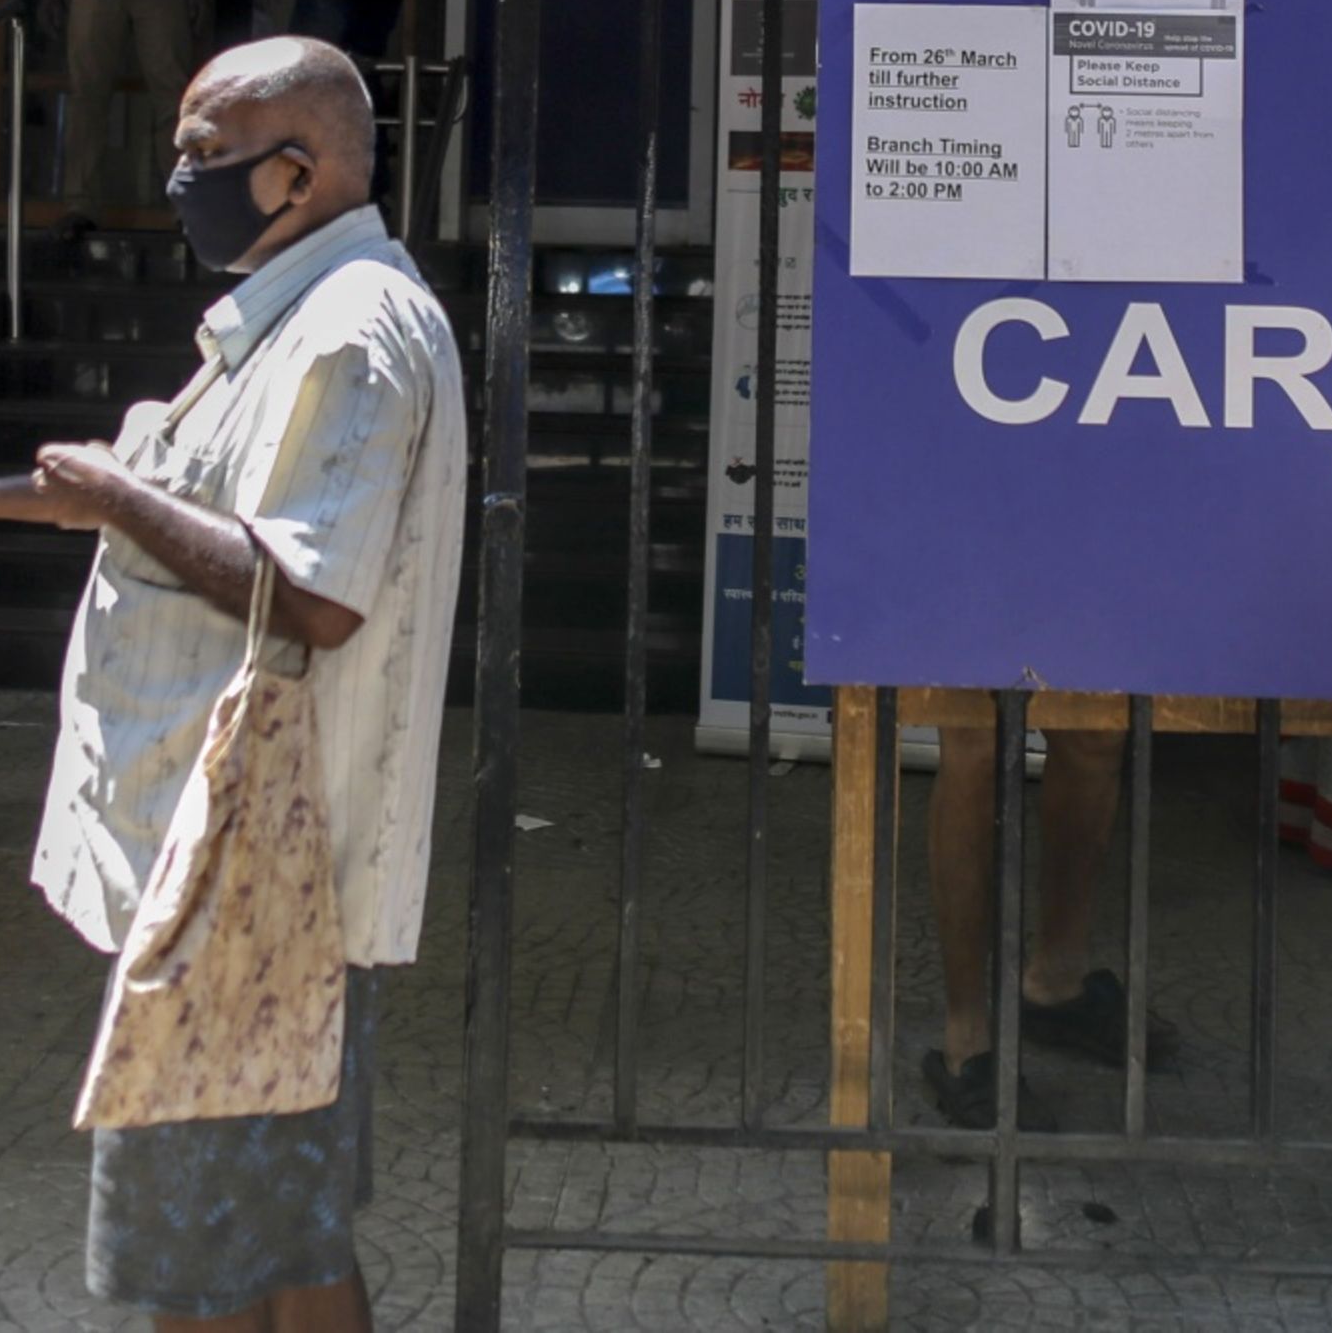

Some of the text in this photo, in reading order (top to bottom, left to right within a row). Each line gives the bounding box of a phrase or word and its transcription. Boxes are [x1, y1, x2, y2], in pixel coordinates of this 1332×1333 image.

[1069, 20, 1155, 38] COVID-19
[1069, 40, 1095, 49] Novel
[869, 47, 917, 64] From
[961, 50, 1017, 67] March
[1077, 59, 1160, 74] Please Keep
[869, 70, 959, 87] till further
[1077, 74, 1181, 88] Social Distance
[868, 92, 967, 109] instruction
[868, 136, 1003, 159] Branch Timing
[866, 158, 1017, 178] Will be 10:00 AM
[866, 182, 963, 199] to 2:00 PM
